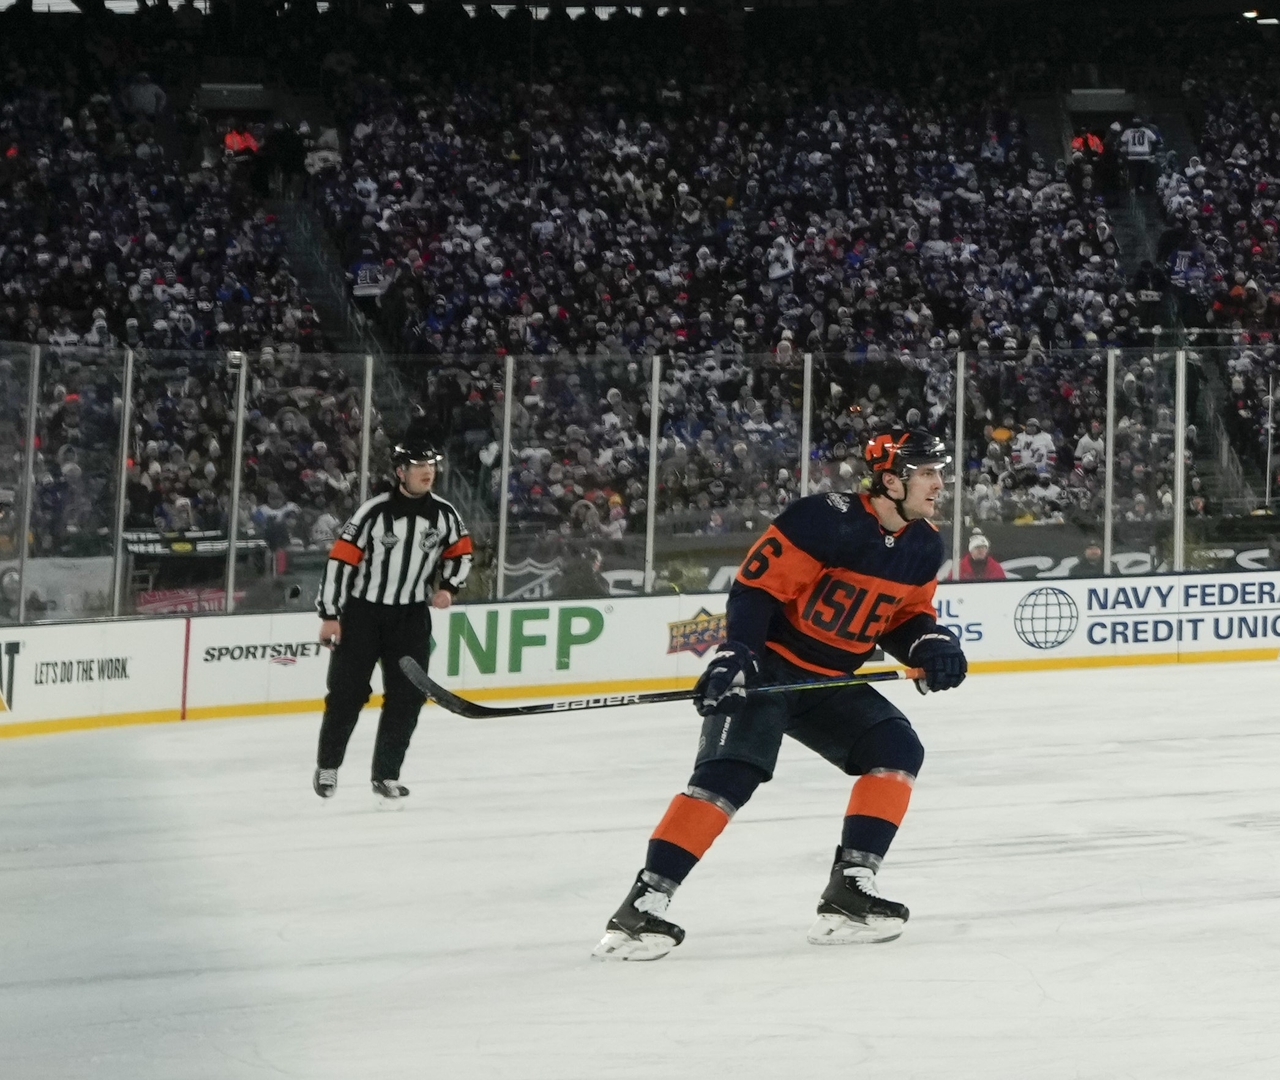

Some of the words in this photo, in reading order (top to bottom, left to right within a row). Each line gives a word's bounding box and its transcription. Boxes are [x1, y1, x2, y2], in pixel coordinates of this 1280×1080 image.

[741, 537, 782, 581] 6
[1086, 585, 1175, 611] NAVY
[447, 606, 605, 678] NFP
[1087, 617, 1175, 646] CREDIT
[203, 642, 324, 663] SPORTSNET
[34, 660, 58, 686] LET'S
[60, 659, 74, 684] DO
[75, 658, 94, 683] THE
[96, 656, 131, 682] WORK.
[552, 693, 640, 712] BAUER
[719, 715, 732, 747] BAUER
